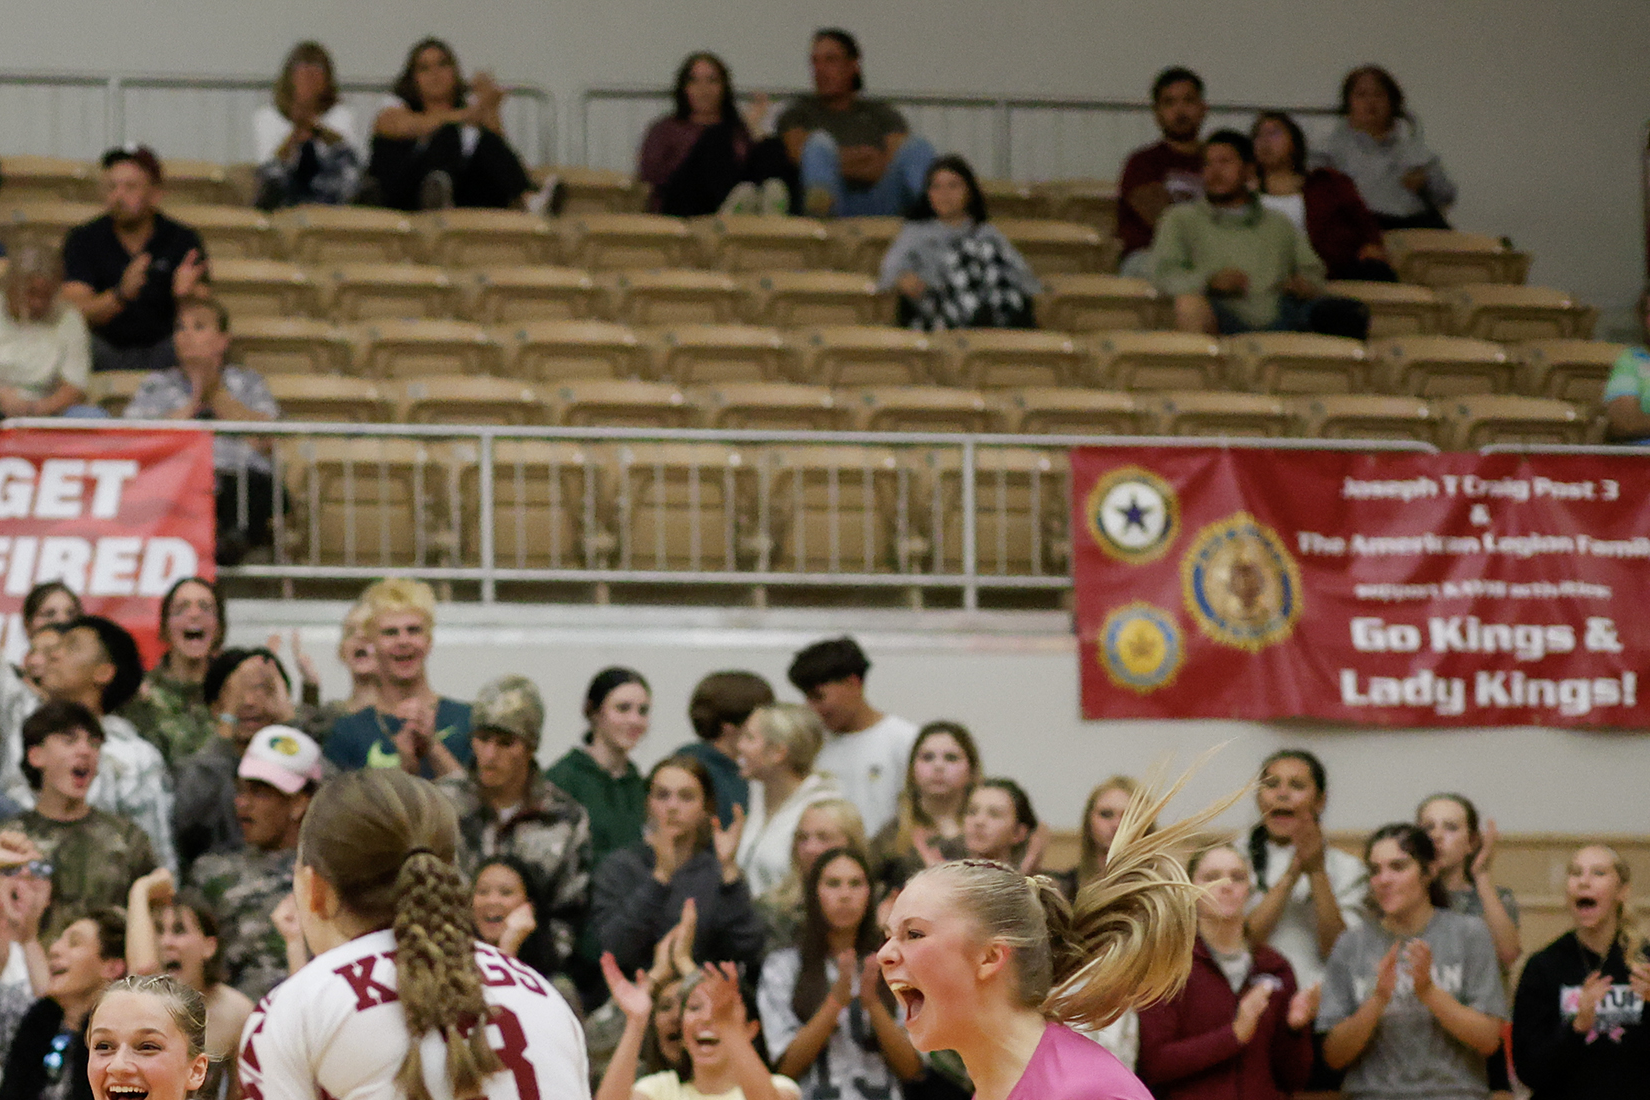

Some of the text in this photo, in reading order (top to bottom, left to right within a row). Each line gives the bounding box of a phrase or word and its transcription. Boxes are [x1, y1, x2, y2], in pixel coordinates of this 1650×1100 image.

[1602, 479, 1618, 499] 3
[1350, 615, 1624, 662] Go Kings &
[1340, 668, 1637, 716] Lady Kings!
